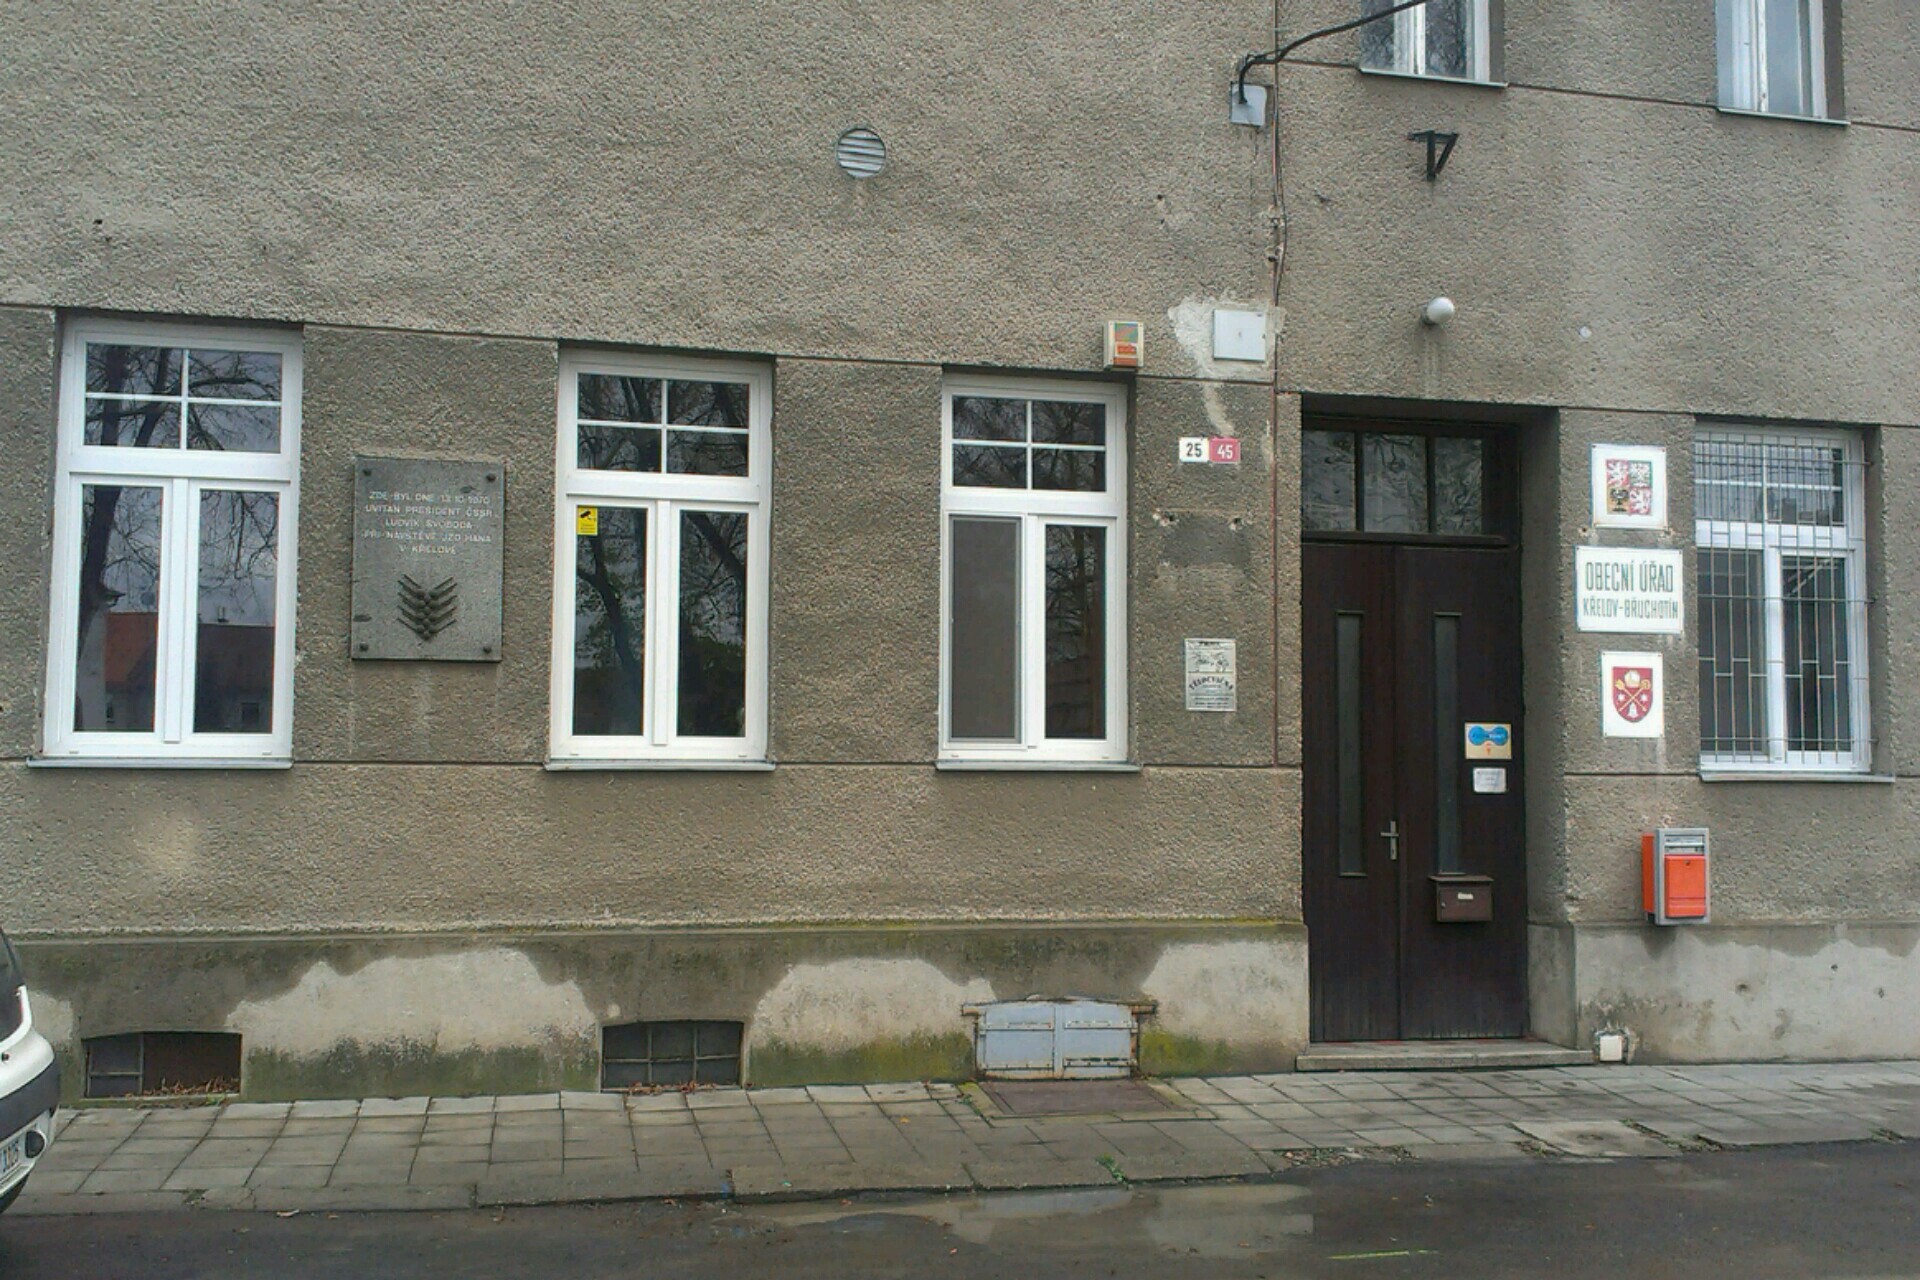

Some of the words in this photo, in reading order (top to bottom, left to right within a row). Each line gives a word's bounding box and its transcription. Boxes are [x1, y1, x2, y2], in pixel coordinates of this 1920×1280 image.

[1186, 442, 1202, 458] 25
[1217, 444, 1233, 460] 45
[393, 492, 411, 501] BYL
[1585, 560, 1635, 592] OBECNÍ
[1639, 560, 1674, 593] ÚŘAD
[1583, 595, 1679, 620] KŘELOV-BŘUCHOTÍN
